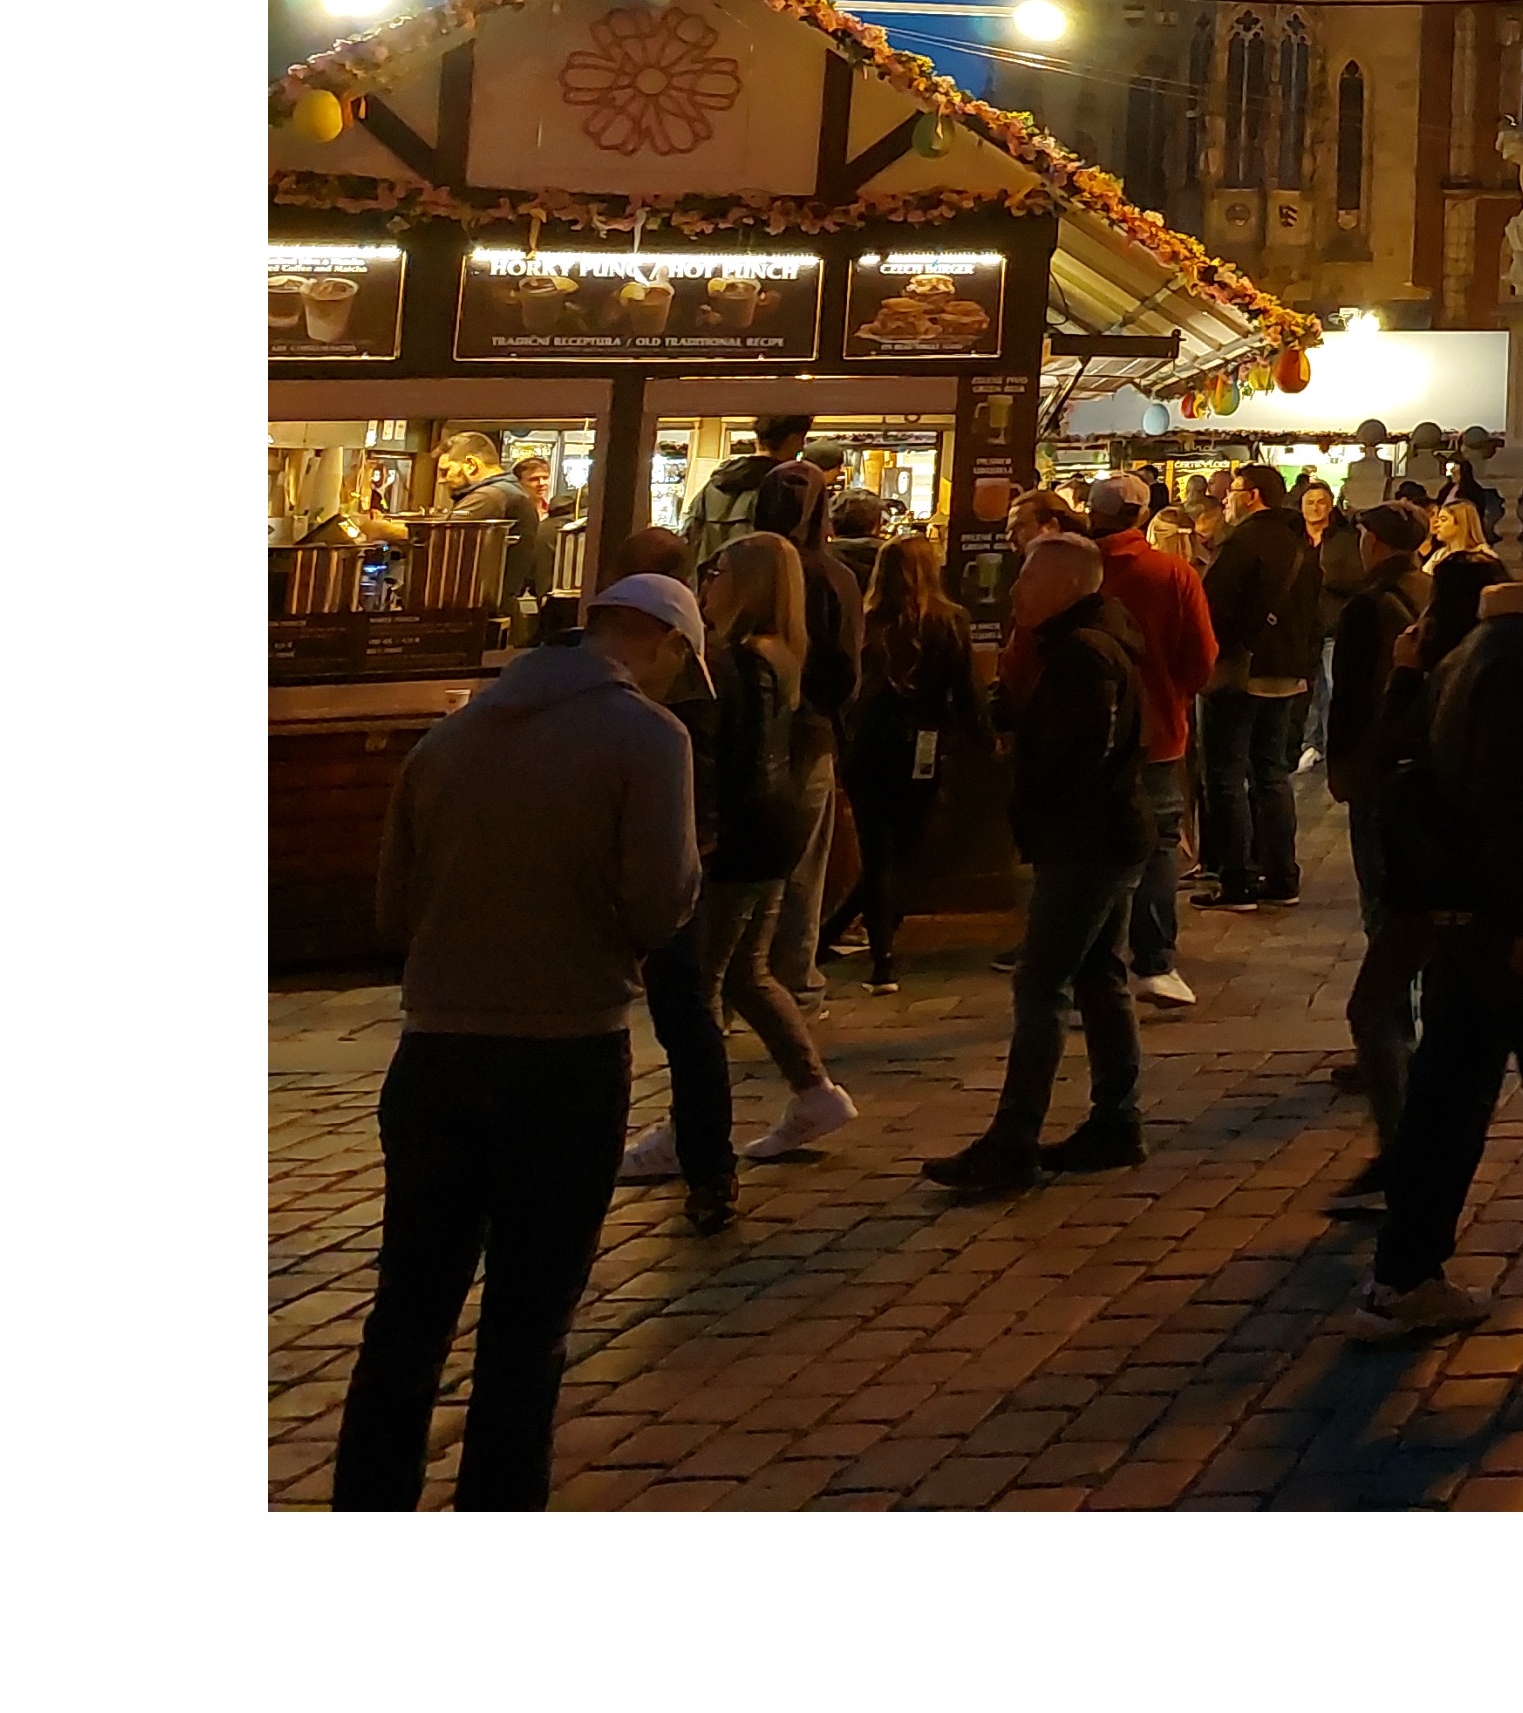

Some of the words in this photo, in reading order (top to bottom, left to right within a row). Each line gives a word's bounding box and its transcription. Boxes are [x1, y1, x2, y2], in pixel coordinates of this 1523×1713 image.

[668, 261, 718, 278] HOT
[720, 261, 801, 280] PUNCH
[553, 336, 622, 347] RECEPTURA
[635, 336, 662, 347] OLD
[664, 337, 743, 348] TRADITIONAL
[746, 338, 786, 348] RECIPE
